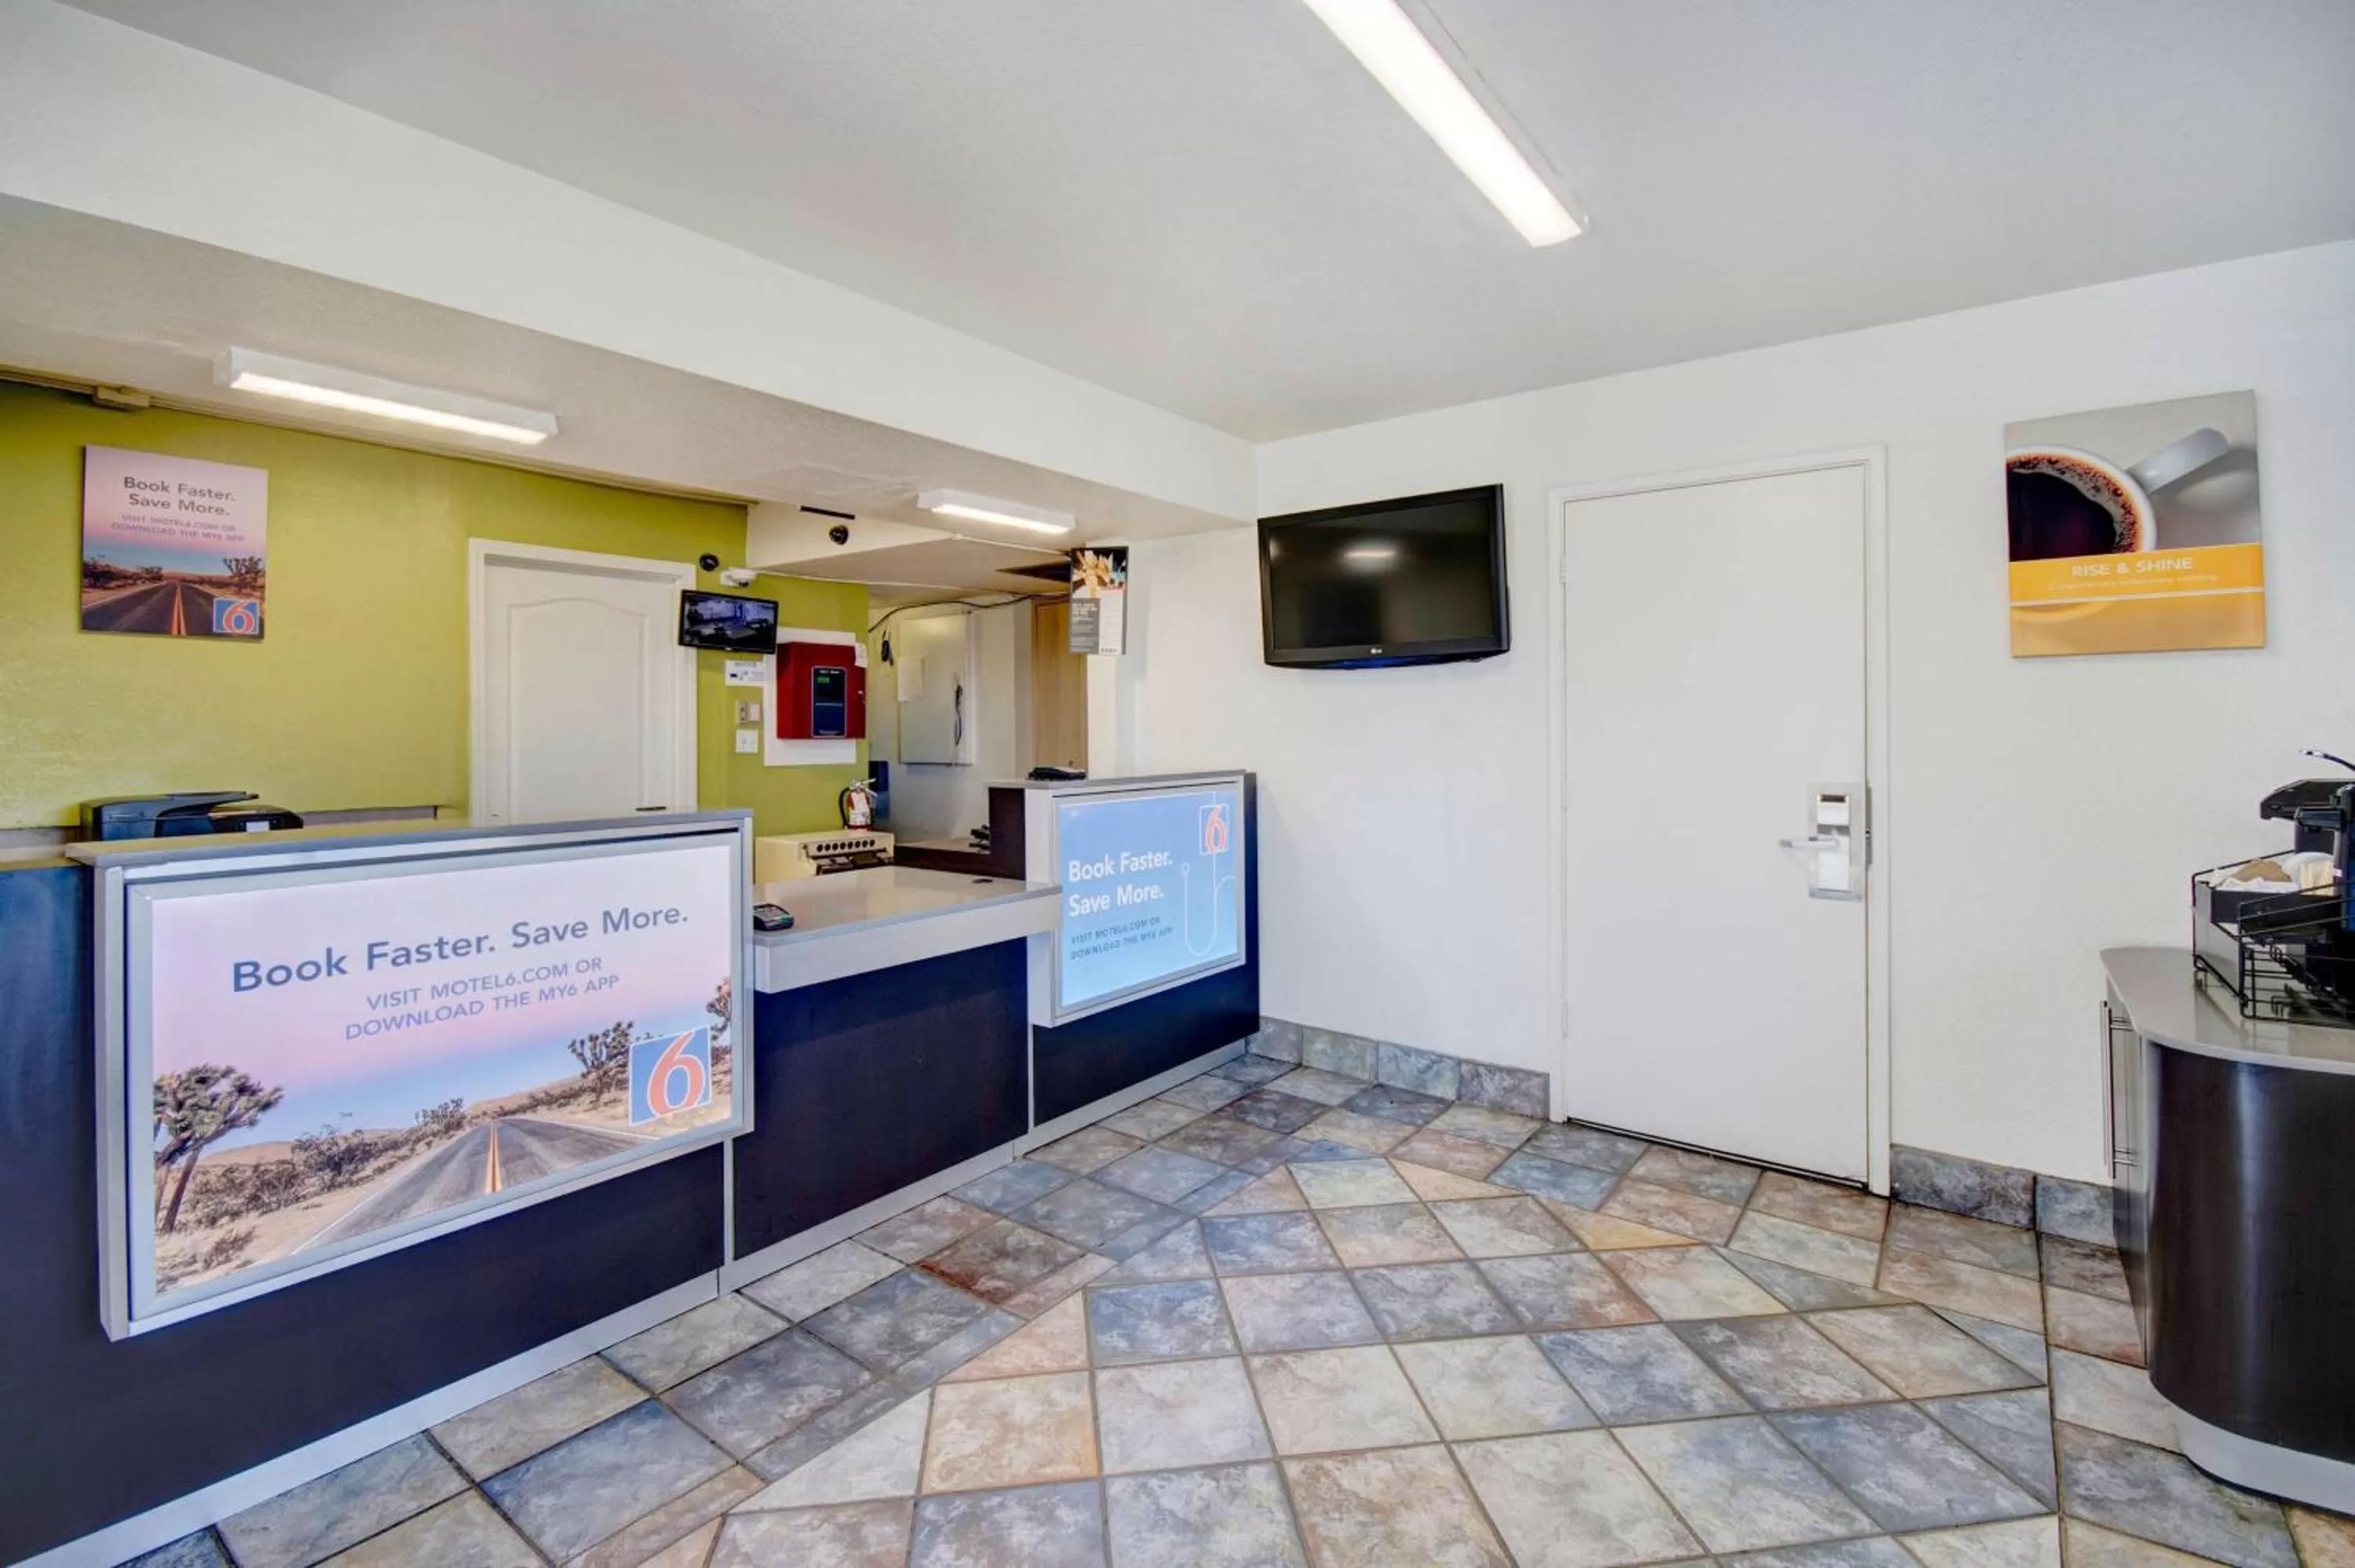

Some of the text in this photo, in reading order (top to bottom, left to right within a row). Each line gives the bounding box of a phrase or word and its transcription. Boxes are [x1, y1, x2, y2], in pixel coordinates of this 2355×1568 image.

[123, 476, 237, 501] Book Faster.
[129, 493, 231, 516] Save More.
[2072, 557, 2193, 578] RISE & SHINE
[222, 600, 255, 634] 6
[1205, 804, 1228, 855] 6
[1068, 849, 1173, 883] Book Faster.
[1068, 882, 1164, 917] Save More.
[233, 906, 688, 993] Book Faster. Save More.
[367, 957, 602, 1012] VISIT MOTEL6.COM OR
[345, 975, 620, 1040] DOWNLOAD THE MY6 APP
[646, 1029, 706, 1118] 6
